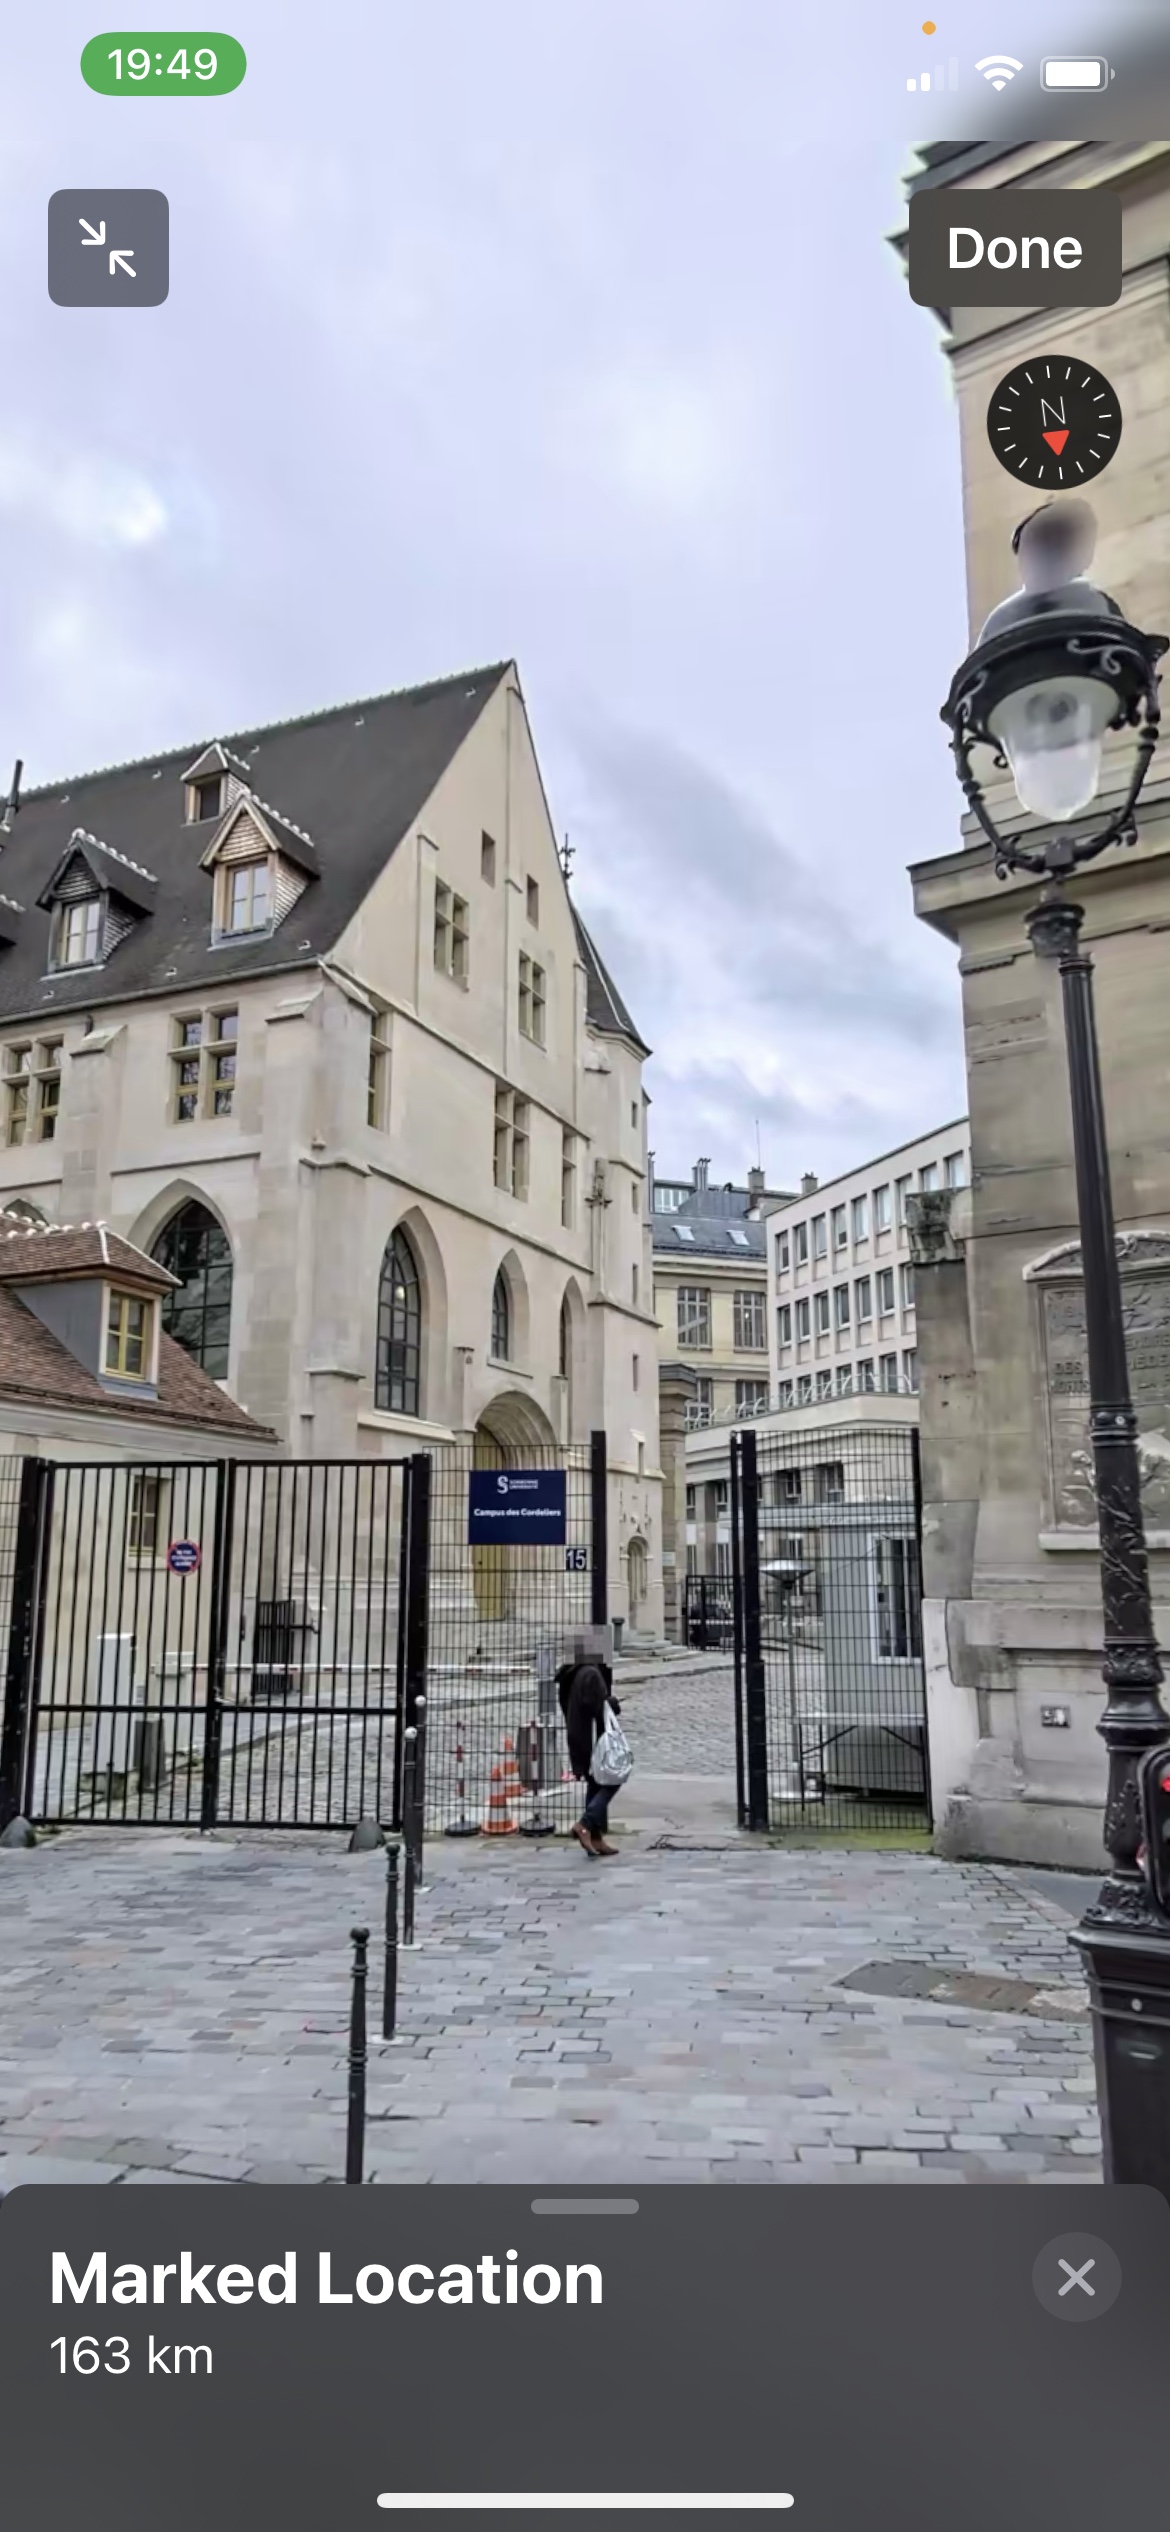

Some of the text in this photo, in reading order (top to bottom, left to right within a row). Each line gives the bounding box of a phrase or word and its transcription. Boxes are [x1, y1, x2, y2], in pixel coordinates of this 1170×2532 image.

[497, 1475, 509, 1494] S
[474, 1508, 561, 1517] Campus des Cordeliers
[567, 1549, 586, 1570] 15
